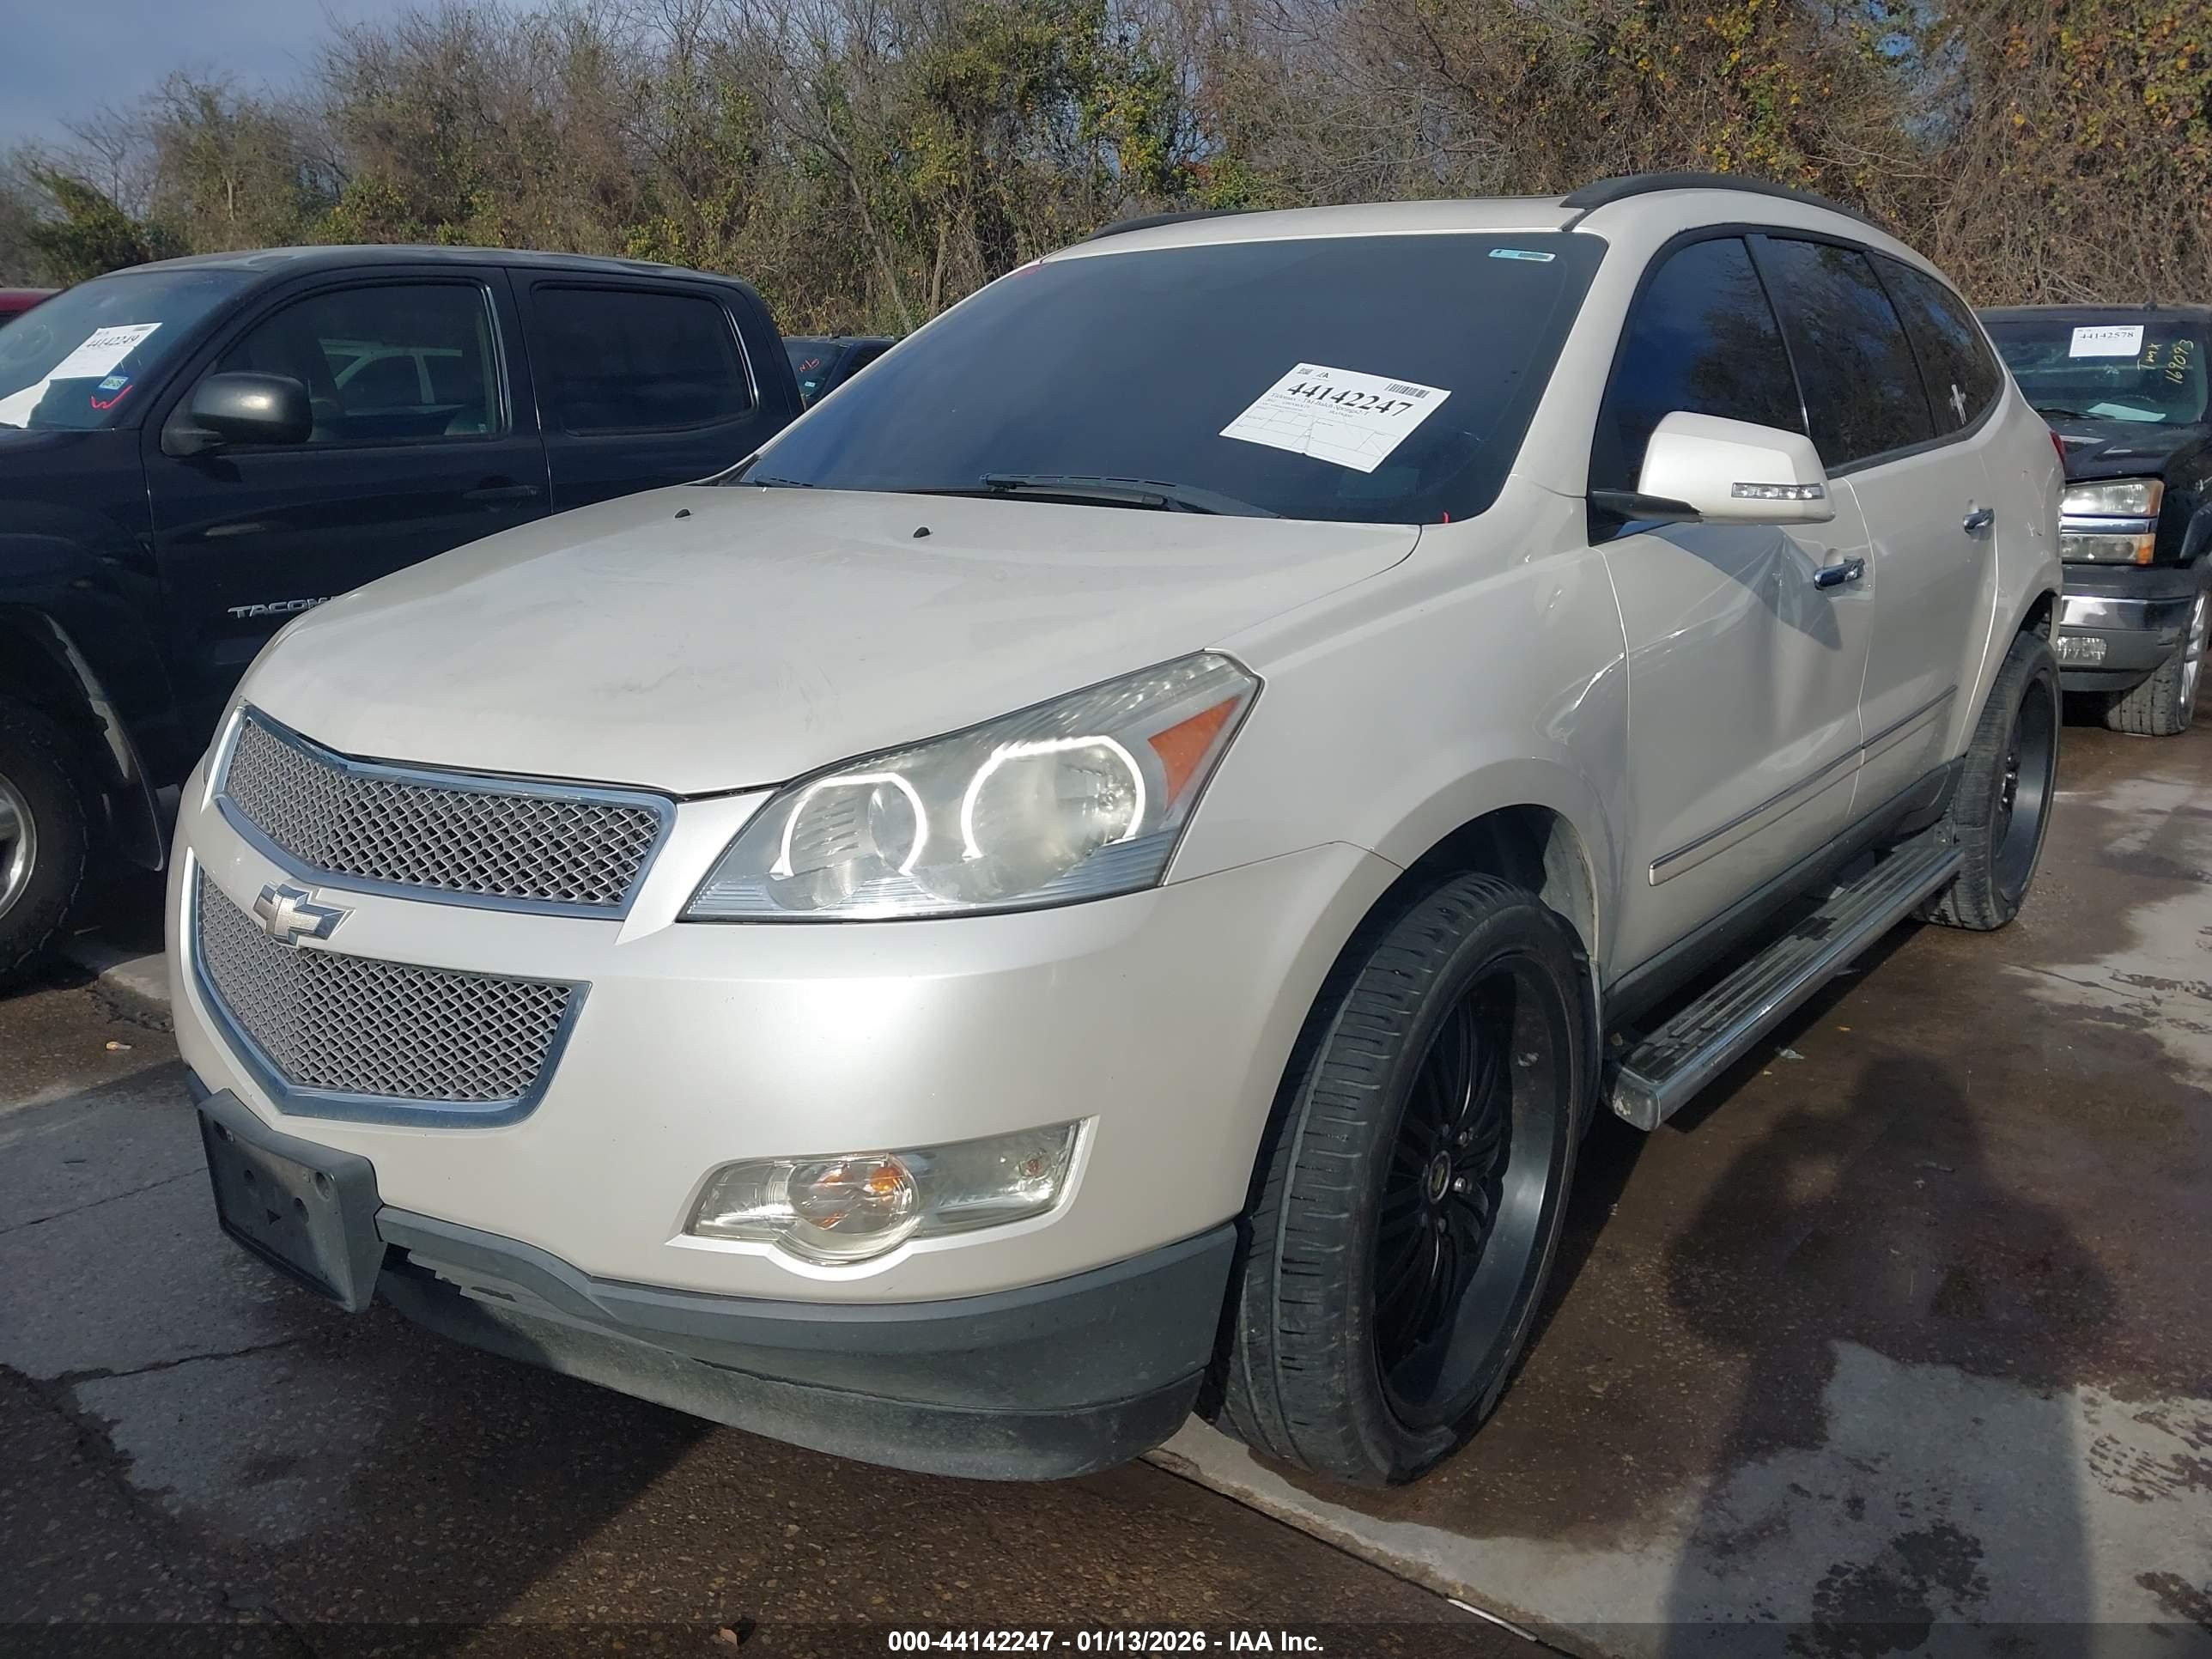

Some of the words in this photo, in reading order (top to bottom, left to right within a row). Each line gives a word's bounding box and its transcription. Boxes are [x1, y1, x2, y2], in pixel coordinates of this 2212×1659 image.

[2080, 331, 2135, 340] 44142578
[2165, 338, 2195, 385] 169093
[1287, 382, 1415, 417] 44142247
[228, 596, 340, 619] TACOM
